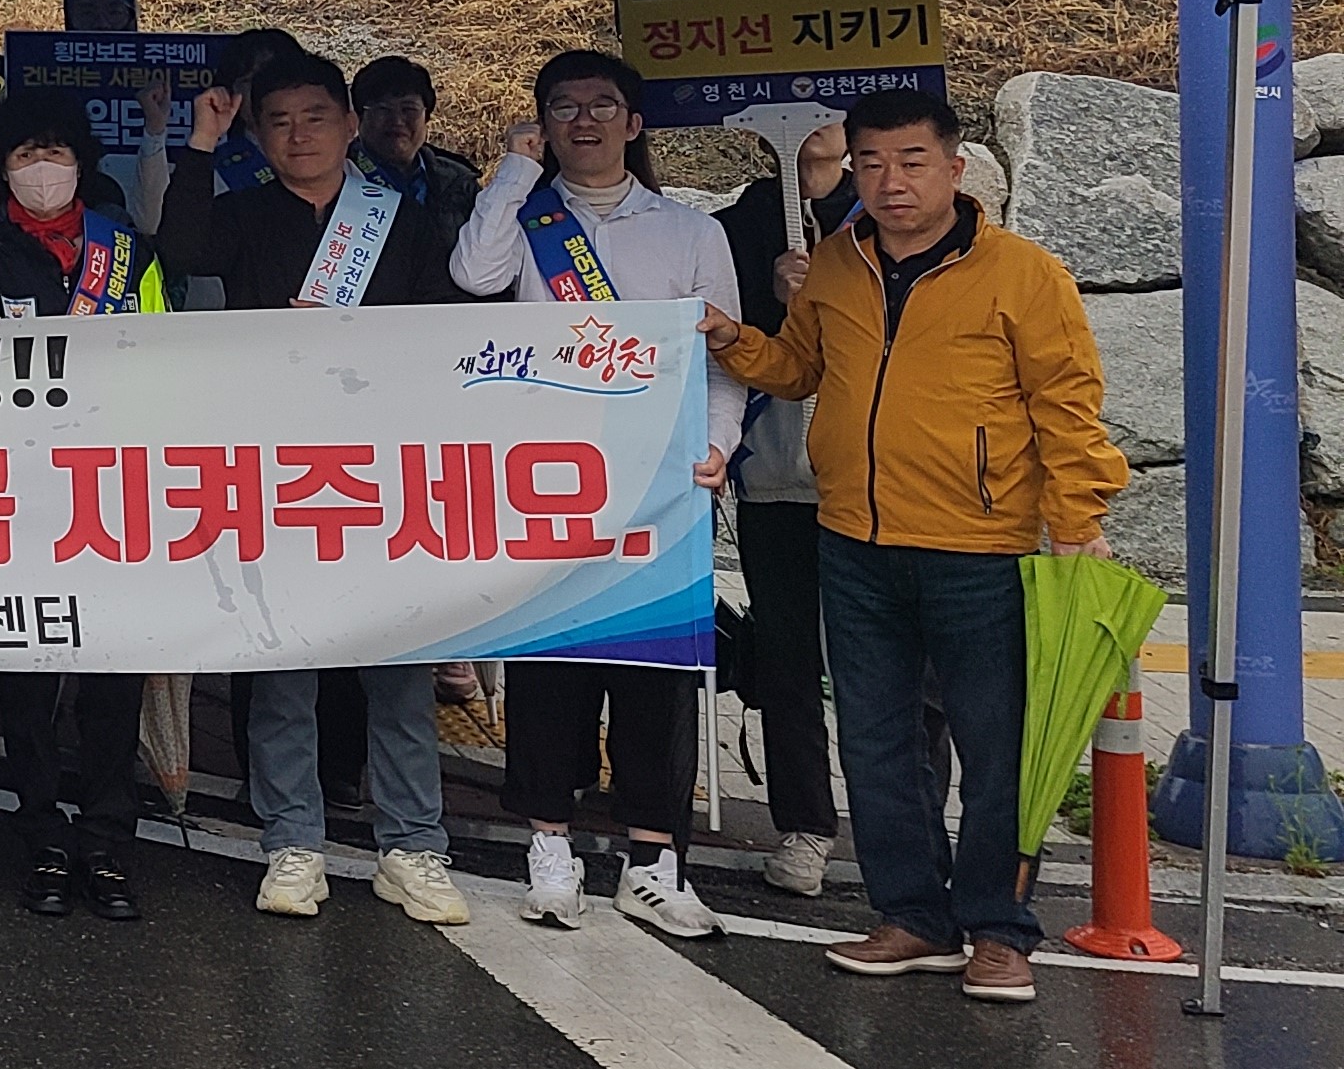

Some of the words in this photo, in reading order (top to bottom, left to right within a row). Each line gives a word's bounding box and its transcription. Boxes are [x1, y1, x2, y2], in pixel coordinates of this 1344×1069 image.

[54, 41, 137, 63] 횡단보도
[143, 43, 206, 65] 주변에
[642, 13, 773, 60] 정지선
[792, 4, 929, 51] 지키기
[22, 65, 102, 88] 건너려는
[702, 82, 772, 103] 영천시
[817, 73, 919, 97] 영천경찰서
[361, 207, 387, 242] 차는
[106, 230, 133, 301] 방어보행
[310, 222, 353, 300] 보행자는
[335, 247, 371, 307] 안전한
[52, 441, 653, 565] 지켜주세요.
